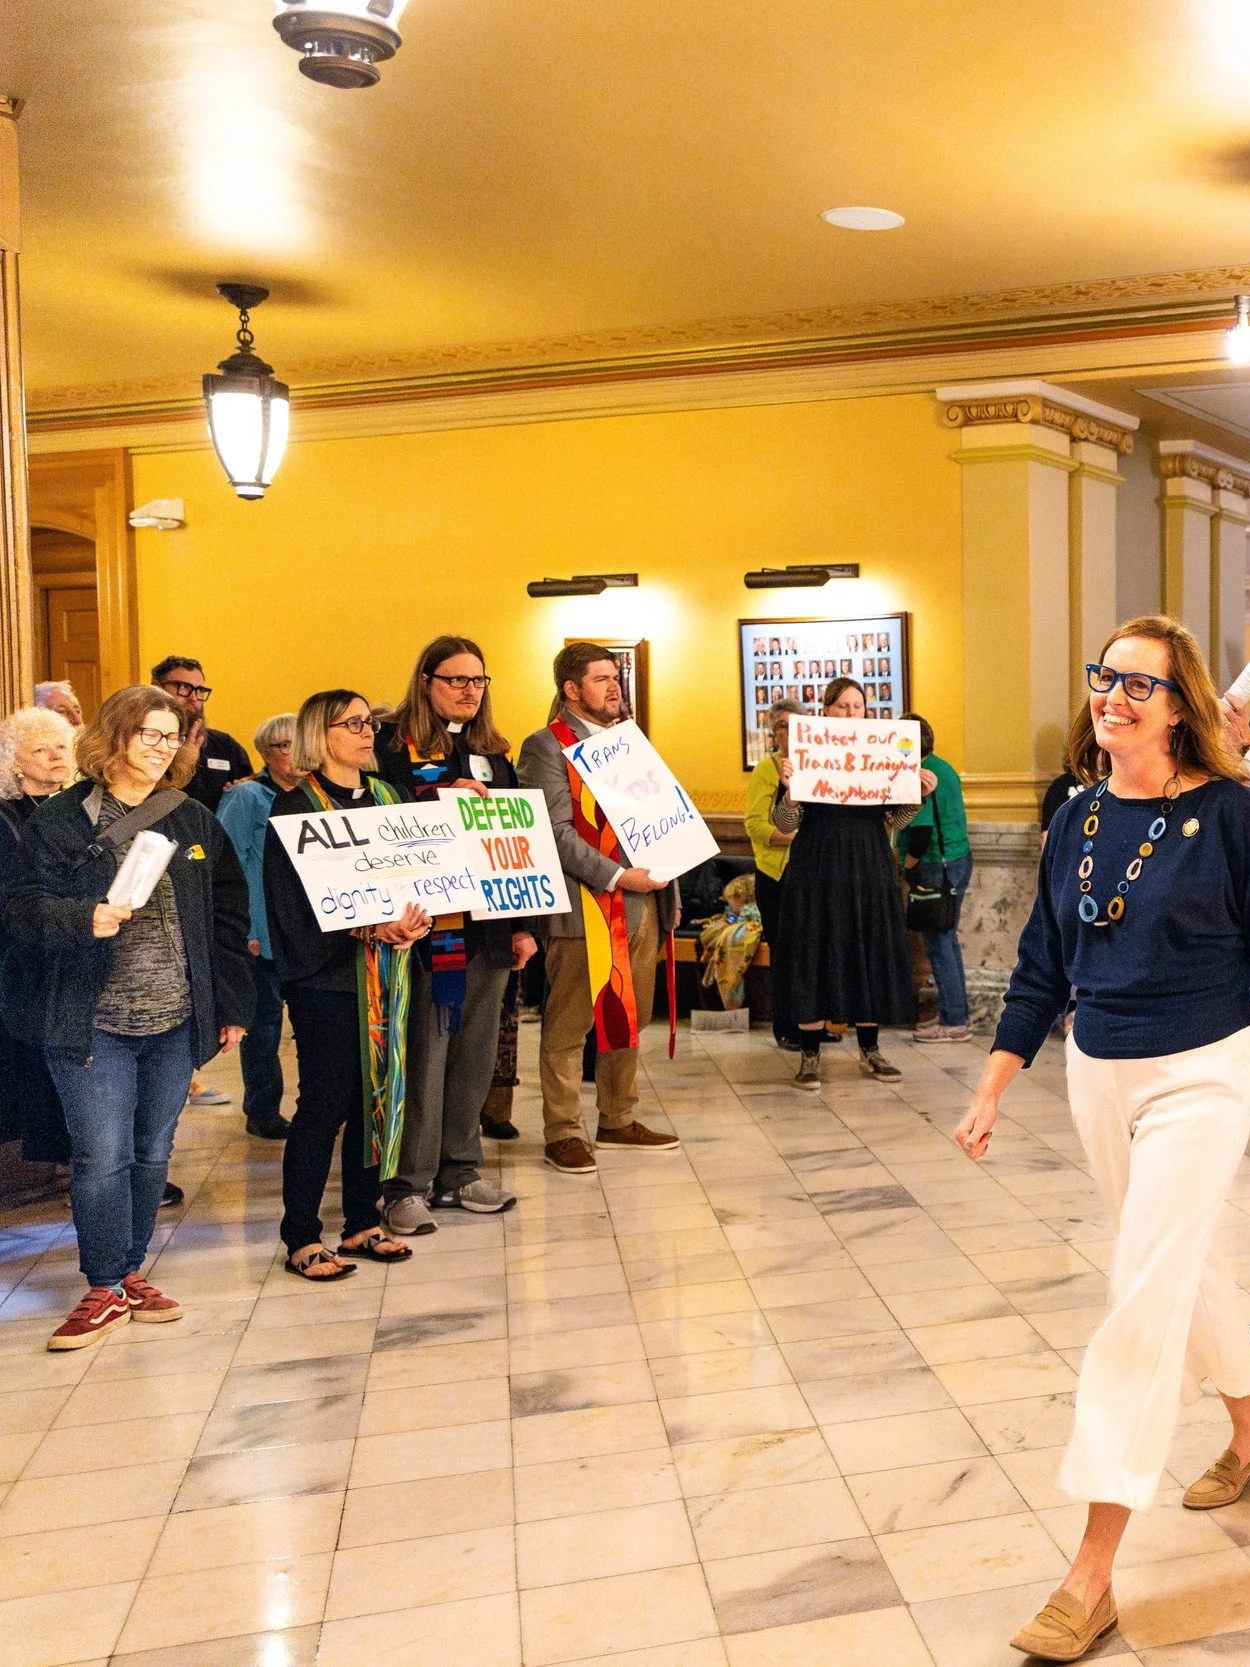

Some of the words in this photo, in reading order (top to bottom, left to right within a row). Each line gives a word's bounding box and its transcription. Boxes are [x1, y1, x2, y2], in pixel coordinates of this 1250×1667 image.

[797, 722, 857, 746] Protect
[867, 731, 897, 744] our
[573, 736, 630, 773] TRANS
[794, 749, 841, 771] Trans
[844, 752, 855, 772] &
[456, 796, 534, 831] DEFEND
[620, 785, 694, 853] BELONG!
[297, 816, 370, 854] ALL
[378, 816, 456, 842] children
[355, 850, 441, 872] deserve
[480, 836, 535, 871] YOUR
[321, 882, 394, 920] dignity
[413, 867, 476, 903] respect
[481, 875, 555, 912] RIGHTS
